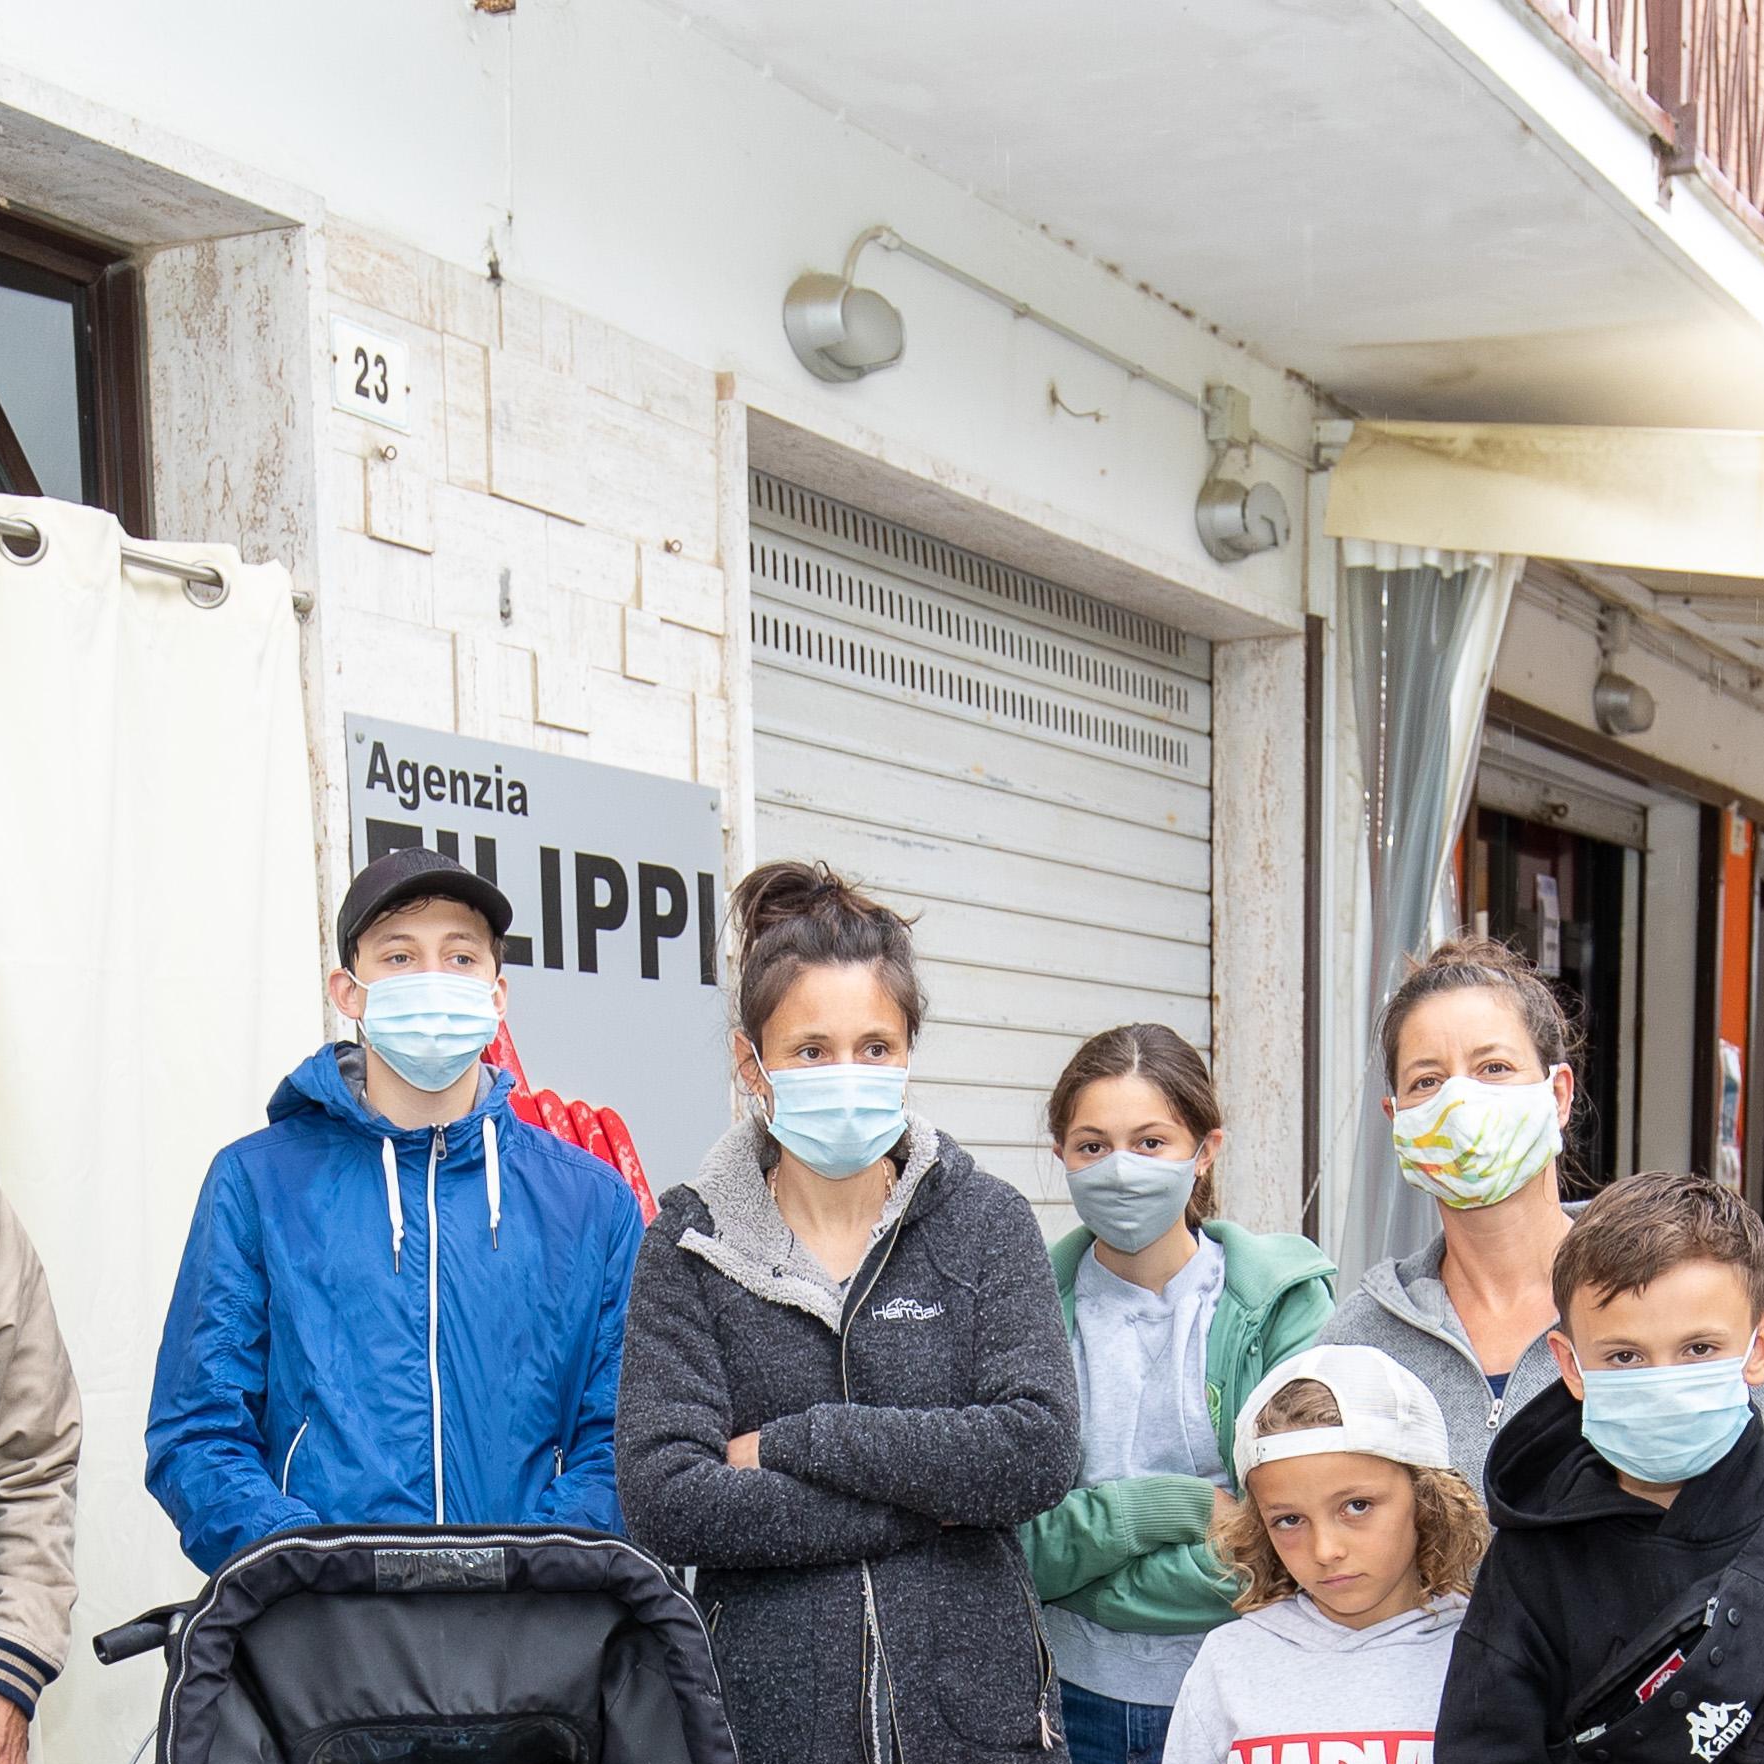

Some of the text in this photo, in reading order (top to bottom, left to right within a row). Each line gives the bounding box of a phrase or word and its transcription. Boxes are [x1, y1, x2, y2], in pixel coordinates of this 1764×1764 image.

[354, 346, 389, 404] 23
[365, 740, 529, 817] Agenzia
[871, 1299, 946, 1321] Heimdall
[1697, 1708, 1752, 1763] Kappa
